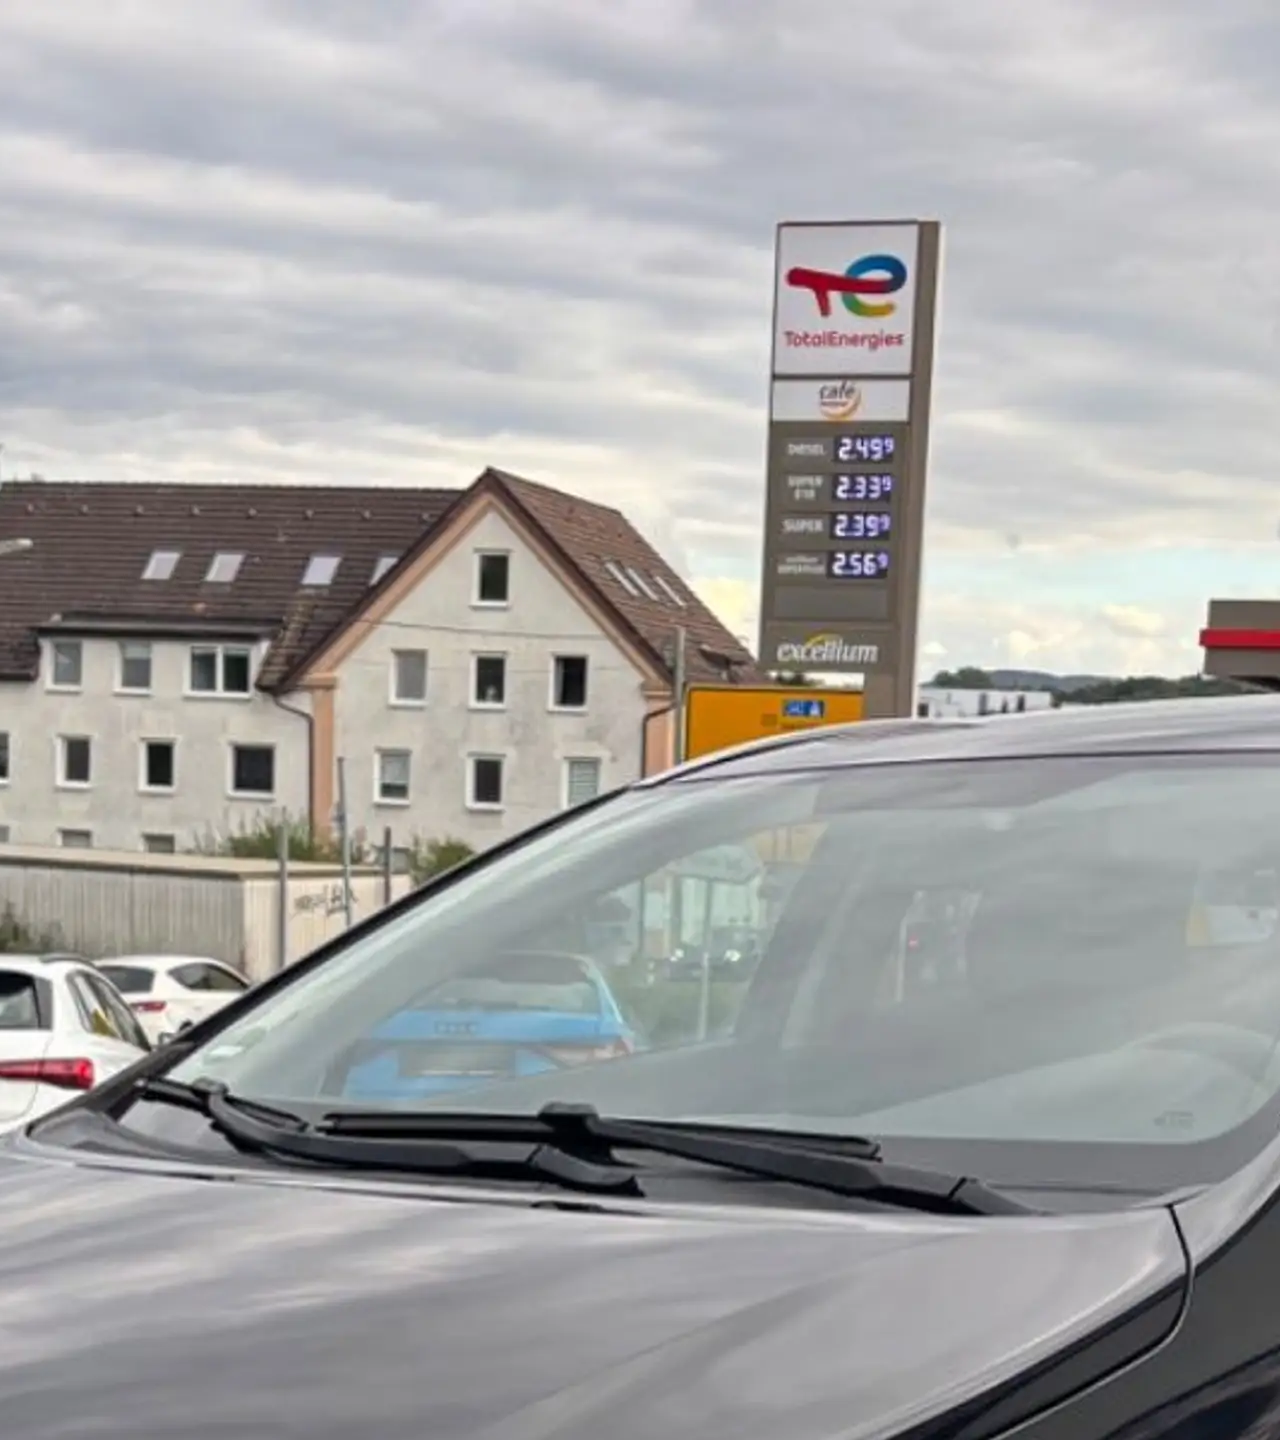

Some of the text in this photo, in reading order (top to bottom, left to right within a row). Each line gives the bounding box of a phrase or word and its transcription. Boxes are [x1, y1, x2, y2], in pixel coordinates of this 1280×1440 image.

[784, 329, 905, 352] TotalEnergies
[787, 443, 826, 456] DIESEL
[782, 518, 823, 533] SUPER
[777, 638, 879, 663] excellium
